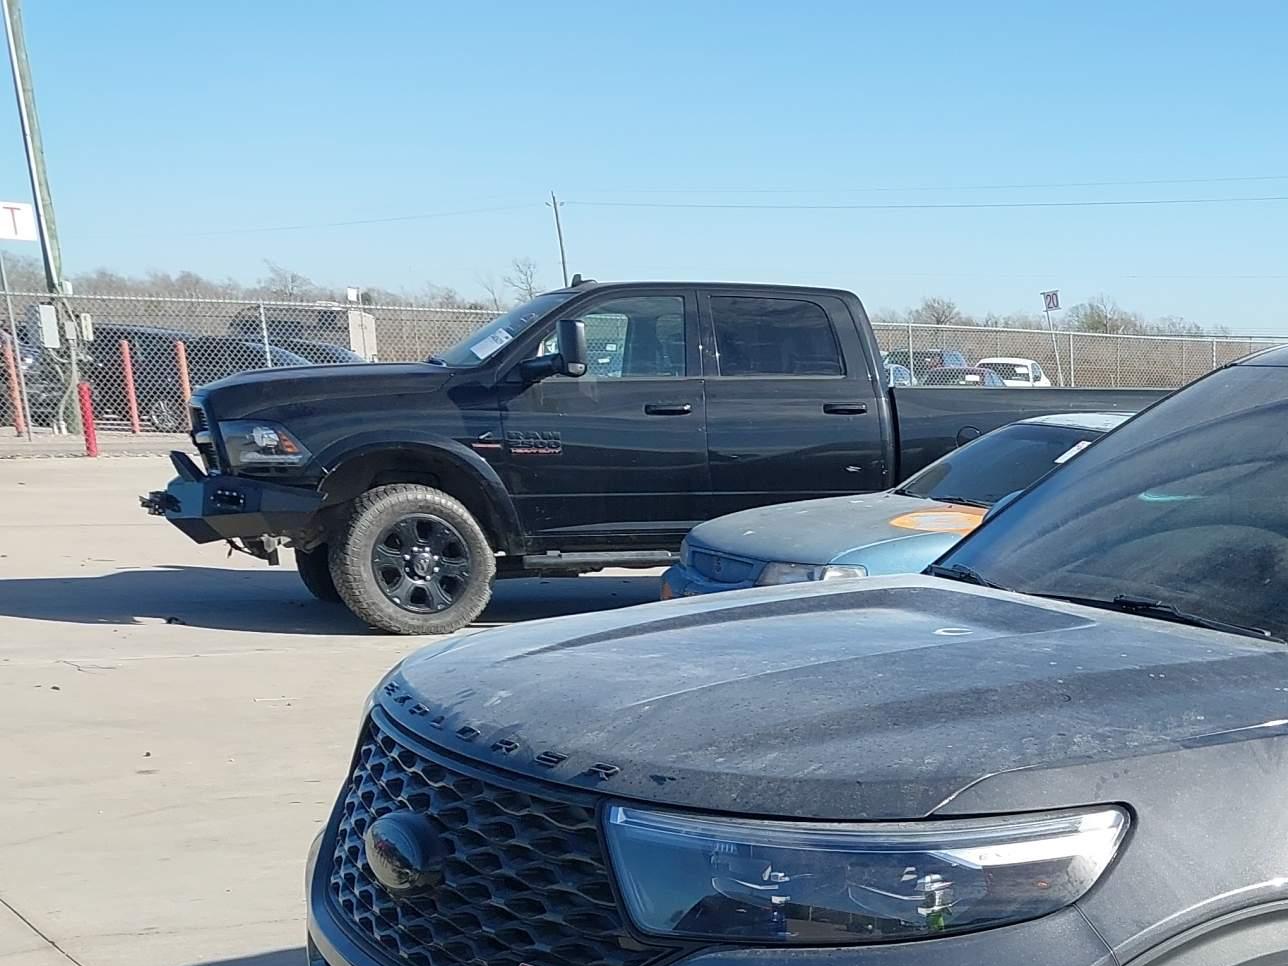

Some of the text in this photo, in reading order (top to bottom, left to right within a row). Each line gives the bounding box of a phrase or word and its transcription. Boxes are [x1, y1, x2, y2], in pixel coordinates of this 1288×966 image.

[1045, 292, 1059, 309] 20
[505, 430, 561, 440] RAM
[508, 440, 561, 448] 2500
[383, 681, 622, 780] EXPLORER
